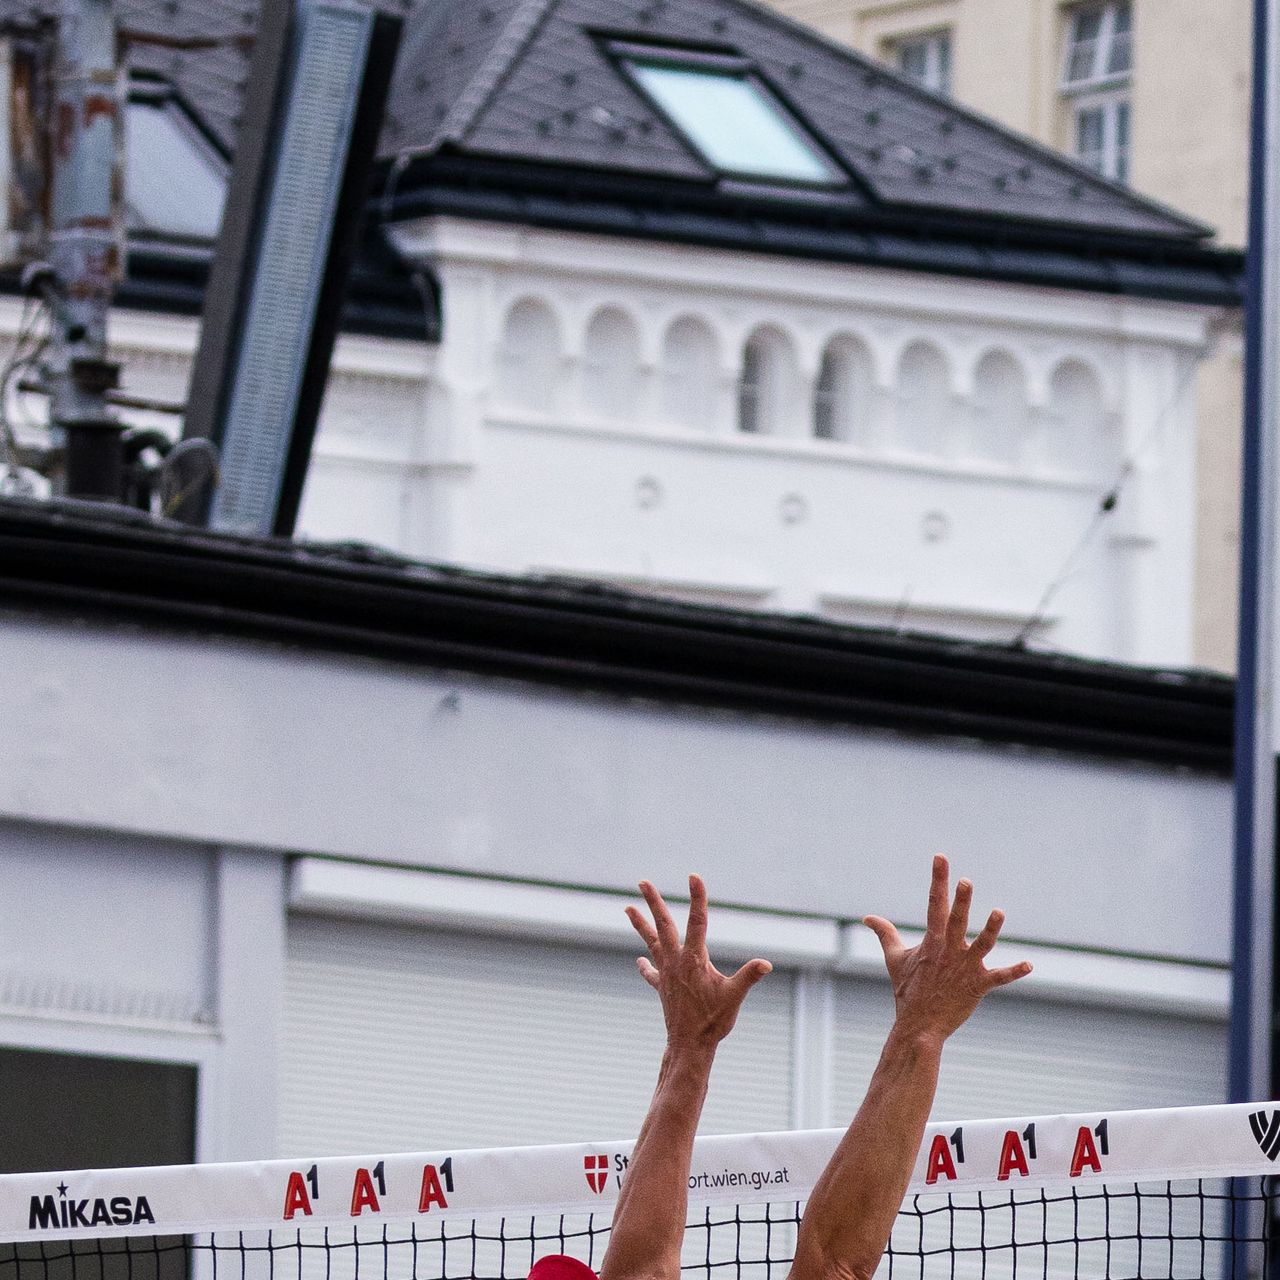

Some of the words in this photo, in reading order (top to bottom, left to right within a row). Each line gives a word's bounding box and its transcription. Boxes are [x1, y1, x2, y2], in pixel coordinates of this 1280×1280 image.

[926, 1126, 965, 1186] A1
[997, 1122, 1038, 1182] A1
[1070, 1118, 1109, 1178] A1
[283, 1164, 319, 1220] A1
[350, 1161, 386, 1217] A1
[417, 1157, 455, 1213] A1
[688, 1166, 790, 1190] ort.wien.gv.at
